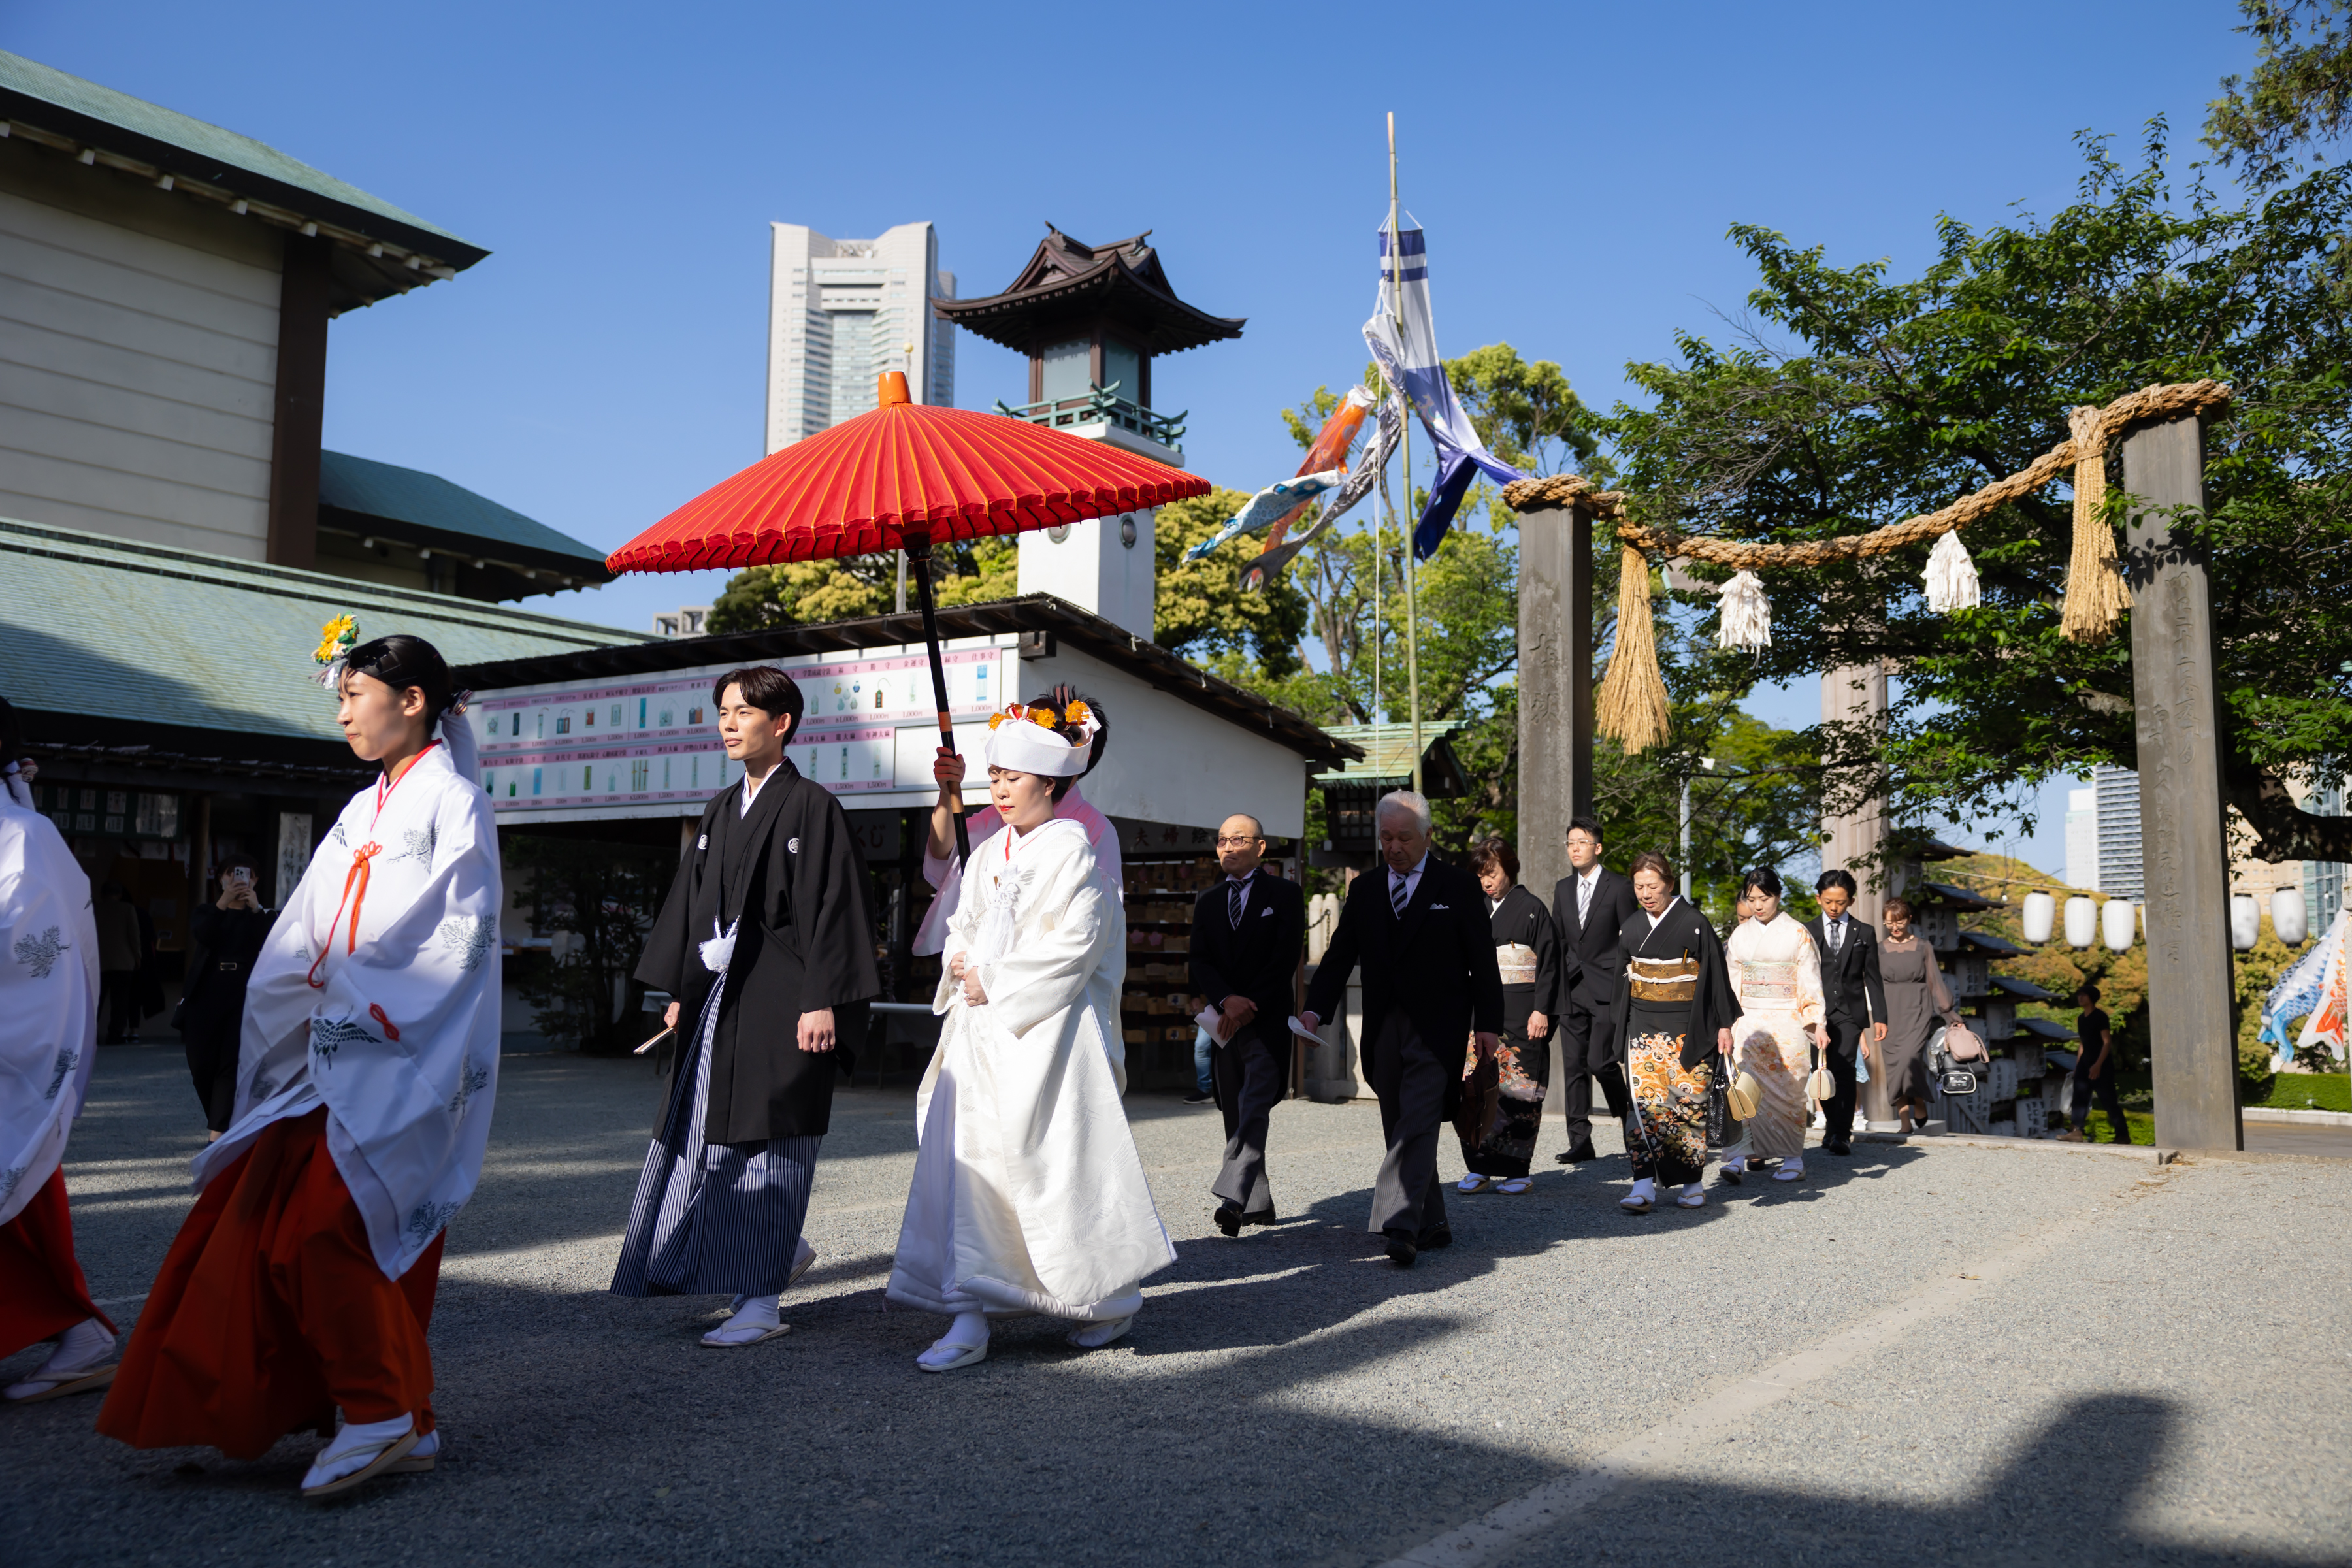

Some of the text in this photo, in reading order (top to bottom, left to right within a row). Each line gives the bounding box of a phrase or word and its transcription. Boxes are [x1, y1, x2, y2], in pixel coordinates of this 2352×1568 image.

[972, 651, 994, 661] 仕事守
[904, 659, 924, 668] 金運守
[1134, 826, 1209, 847] 夫婦絵
